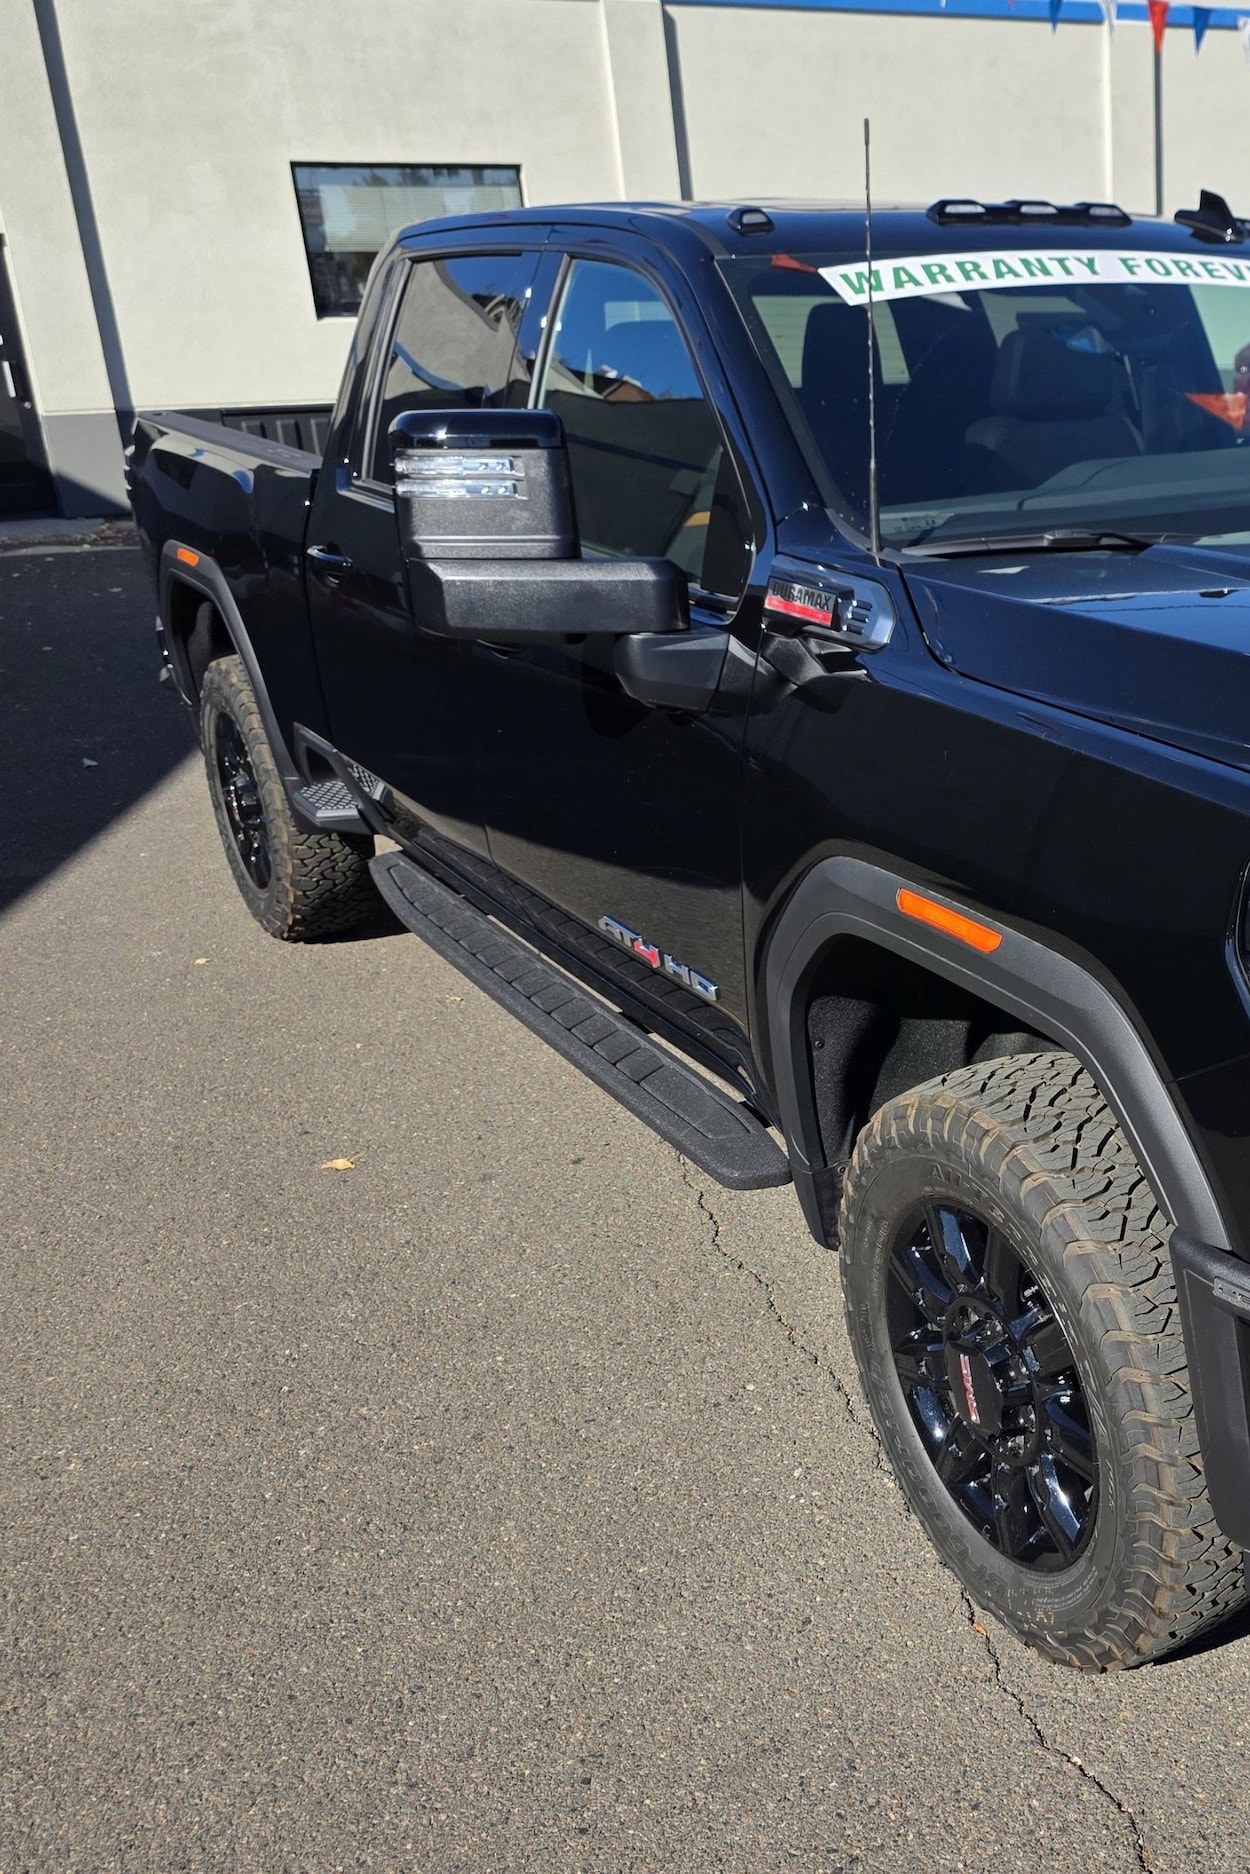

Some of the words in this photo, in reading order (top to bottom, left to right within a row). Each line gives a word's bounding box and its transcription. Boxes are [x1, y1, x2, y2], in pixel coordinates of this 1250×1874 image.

[839, 256, 1101, 296] WARRANTY
[772, 581, 832, 611] DURAMAX
[598, 915, 661, 969] AT4
[663, 953, 721, 1001] HD
